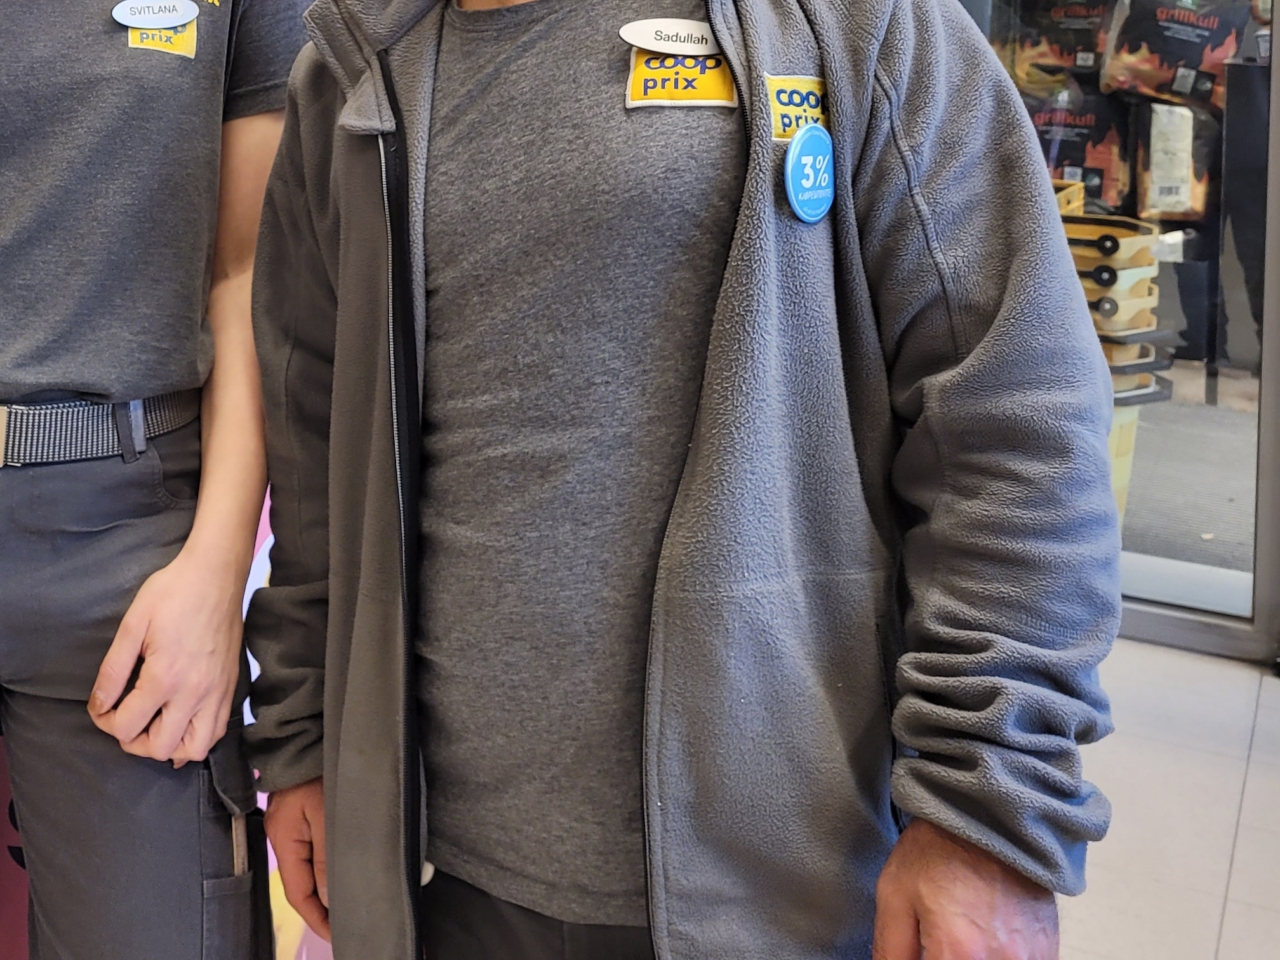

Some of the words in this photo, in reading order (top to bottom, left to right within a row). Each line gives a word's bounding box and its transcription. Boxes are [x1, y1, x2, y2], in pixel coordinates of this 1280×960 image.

[129, 4, 178, 16] SVITLANA
[1156, 6, 1219, 30] grillkull
[140, 30, 174, 45] prix
[654, 30, 709, 45] Sadullah
[643, 55, 722, 74] coop
[643, 71, 699, 96] prix
[1034, 110, 1096, 127] grillkull
[801, 154, 830, 189] 3%
